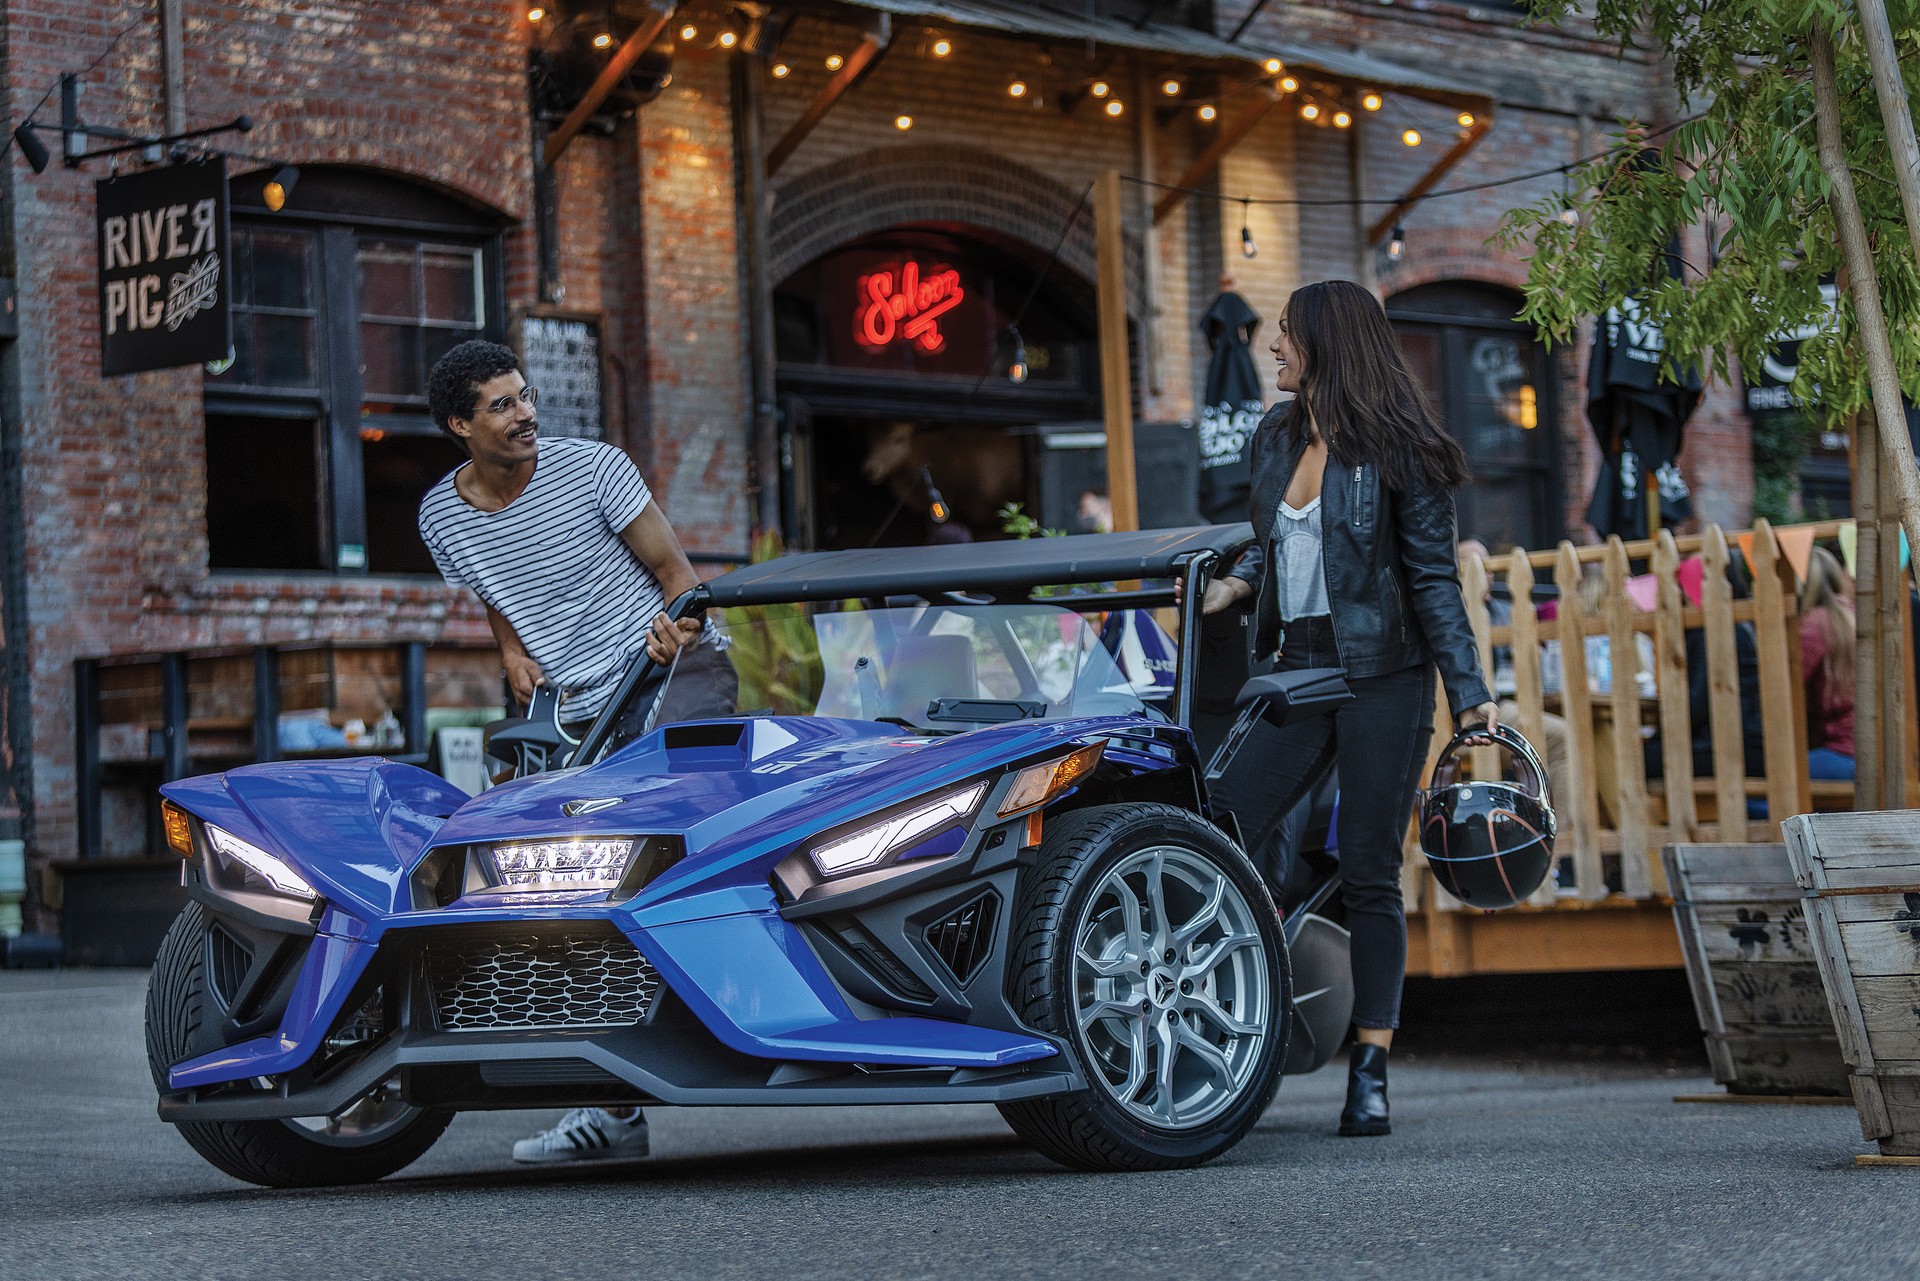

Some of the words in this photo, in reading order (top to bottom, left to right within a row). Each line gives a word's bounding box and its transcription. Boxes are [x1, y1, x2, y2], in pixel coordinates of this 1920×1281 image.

[104, 197, 216, 271] RIVER
[105, 274, 164, 335] PIG
[864, 261, 963, 345] Saloon
